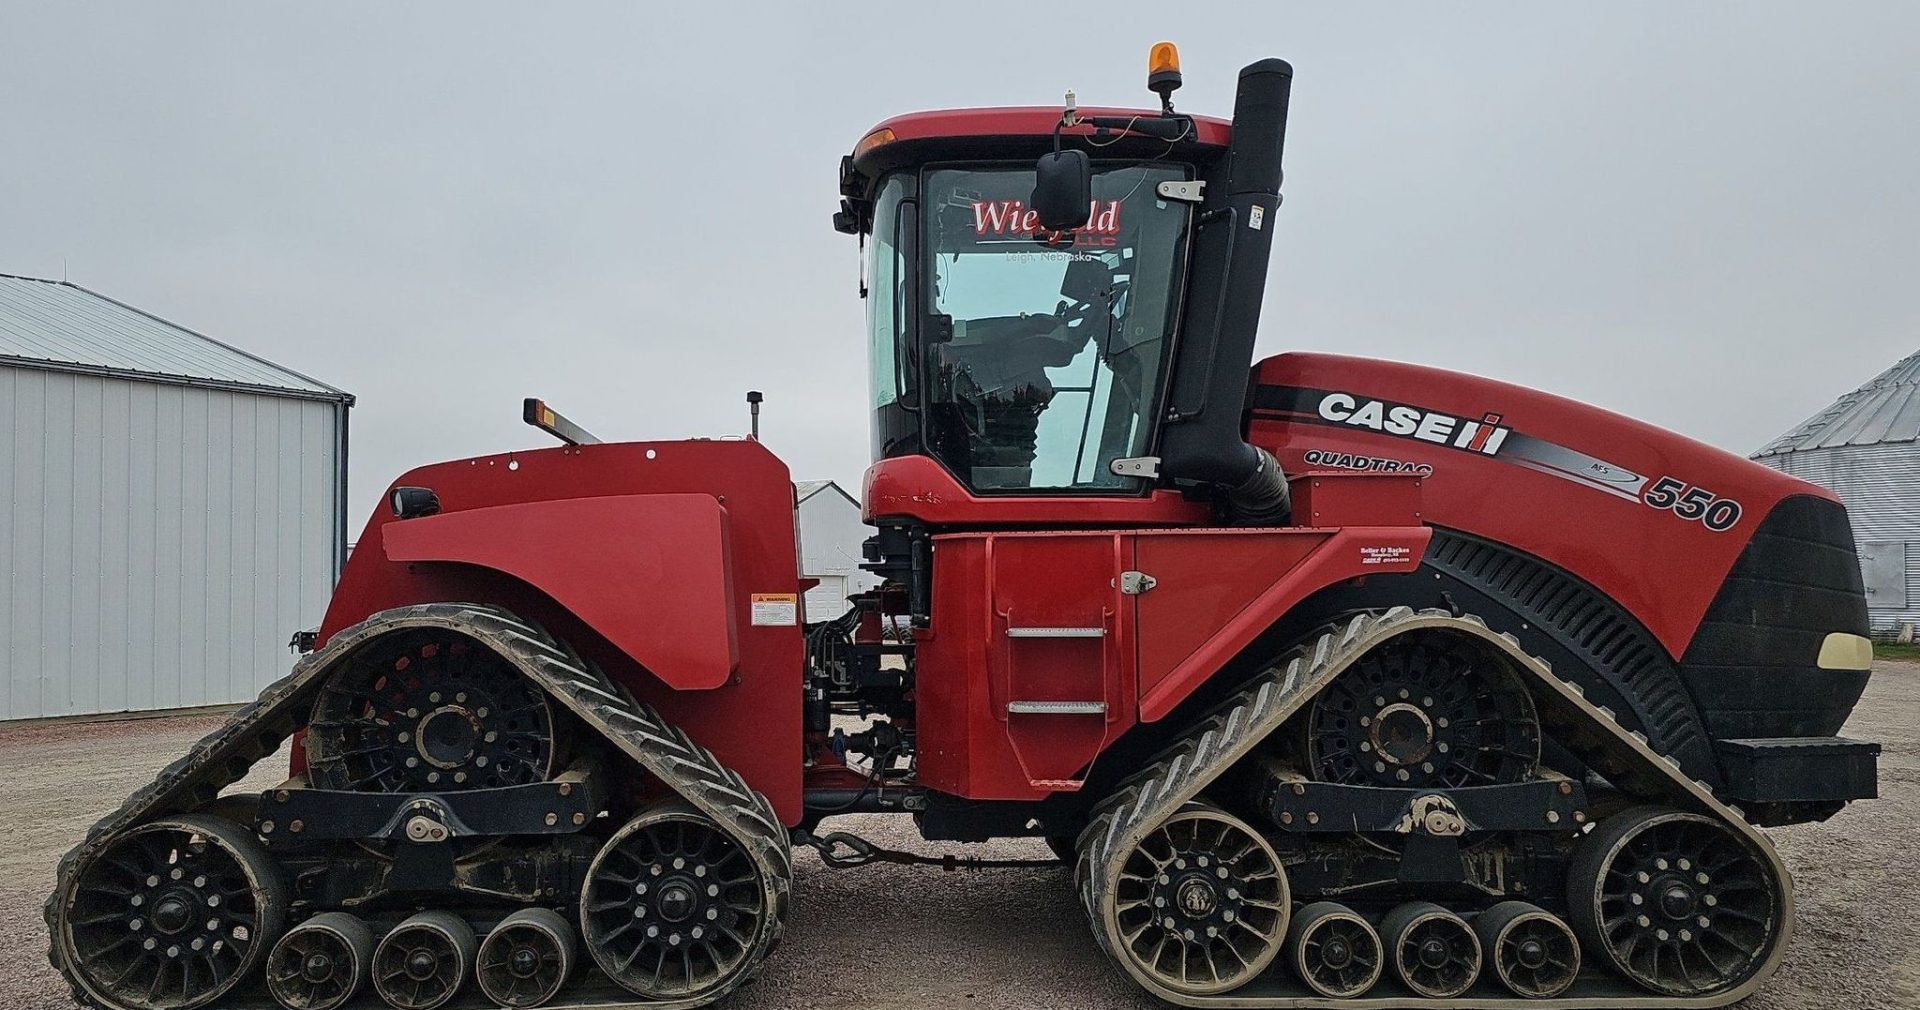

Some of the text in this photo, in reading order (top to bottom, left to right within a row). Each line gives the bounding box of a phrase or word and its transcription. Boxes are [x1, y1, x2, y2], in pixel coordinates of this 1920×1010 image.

[972, 200, 1120, 243] Wield
[1075, 237, 1117, 246] LLC
[1006, 251, 1092, 263] Leigh, Nebraska
[1318, 393, 1456, 443] CASE
[1644, 476, 1743, 532] 550
